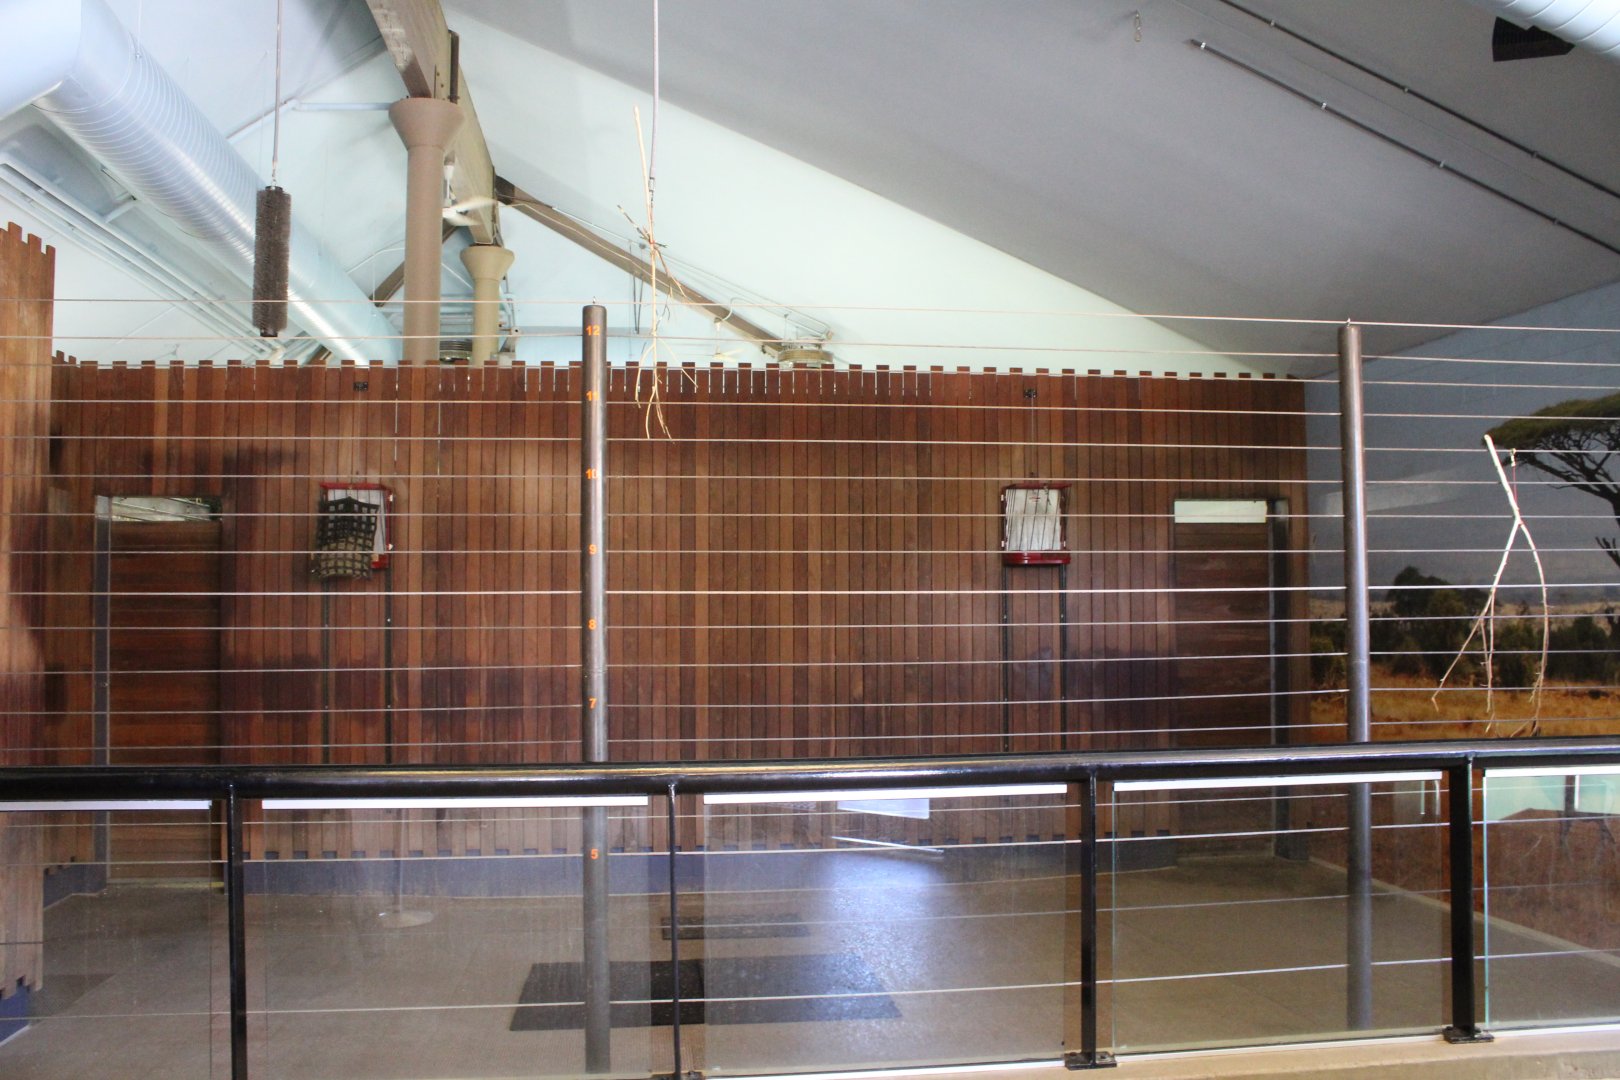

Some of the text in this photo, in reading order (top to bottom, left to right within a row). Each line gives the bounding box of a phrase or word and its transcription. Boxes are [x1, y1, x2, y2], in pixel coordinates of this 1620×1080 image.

[586, 325, 600, 336] 12
[586, 390, 598, 401] 11
[585, 468, 598, 480] 10
[588, 544, 597, 555] 9
[588, 618, 597, 630] 8
[588, 697, 597, 709] 7
[590, 848, 599, 860] 5
